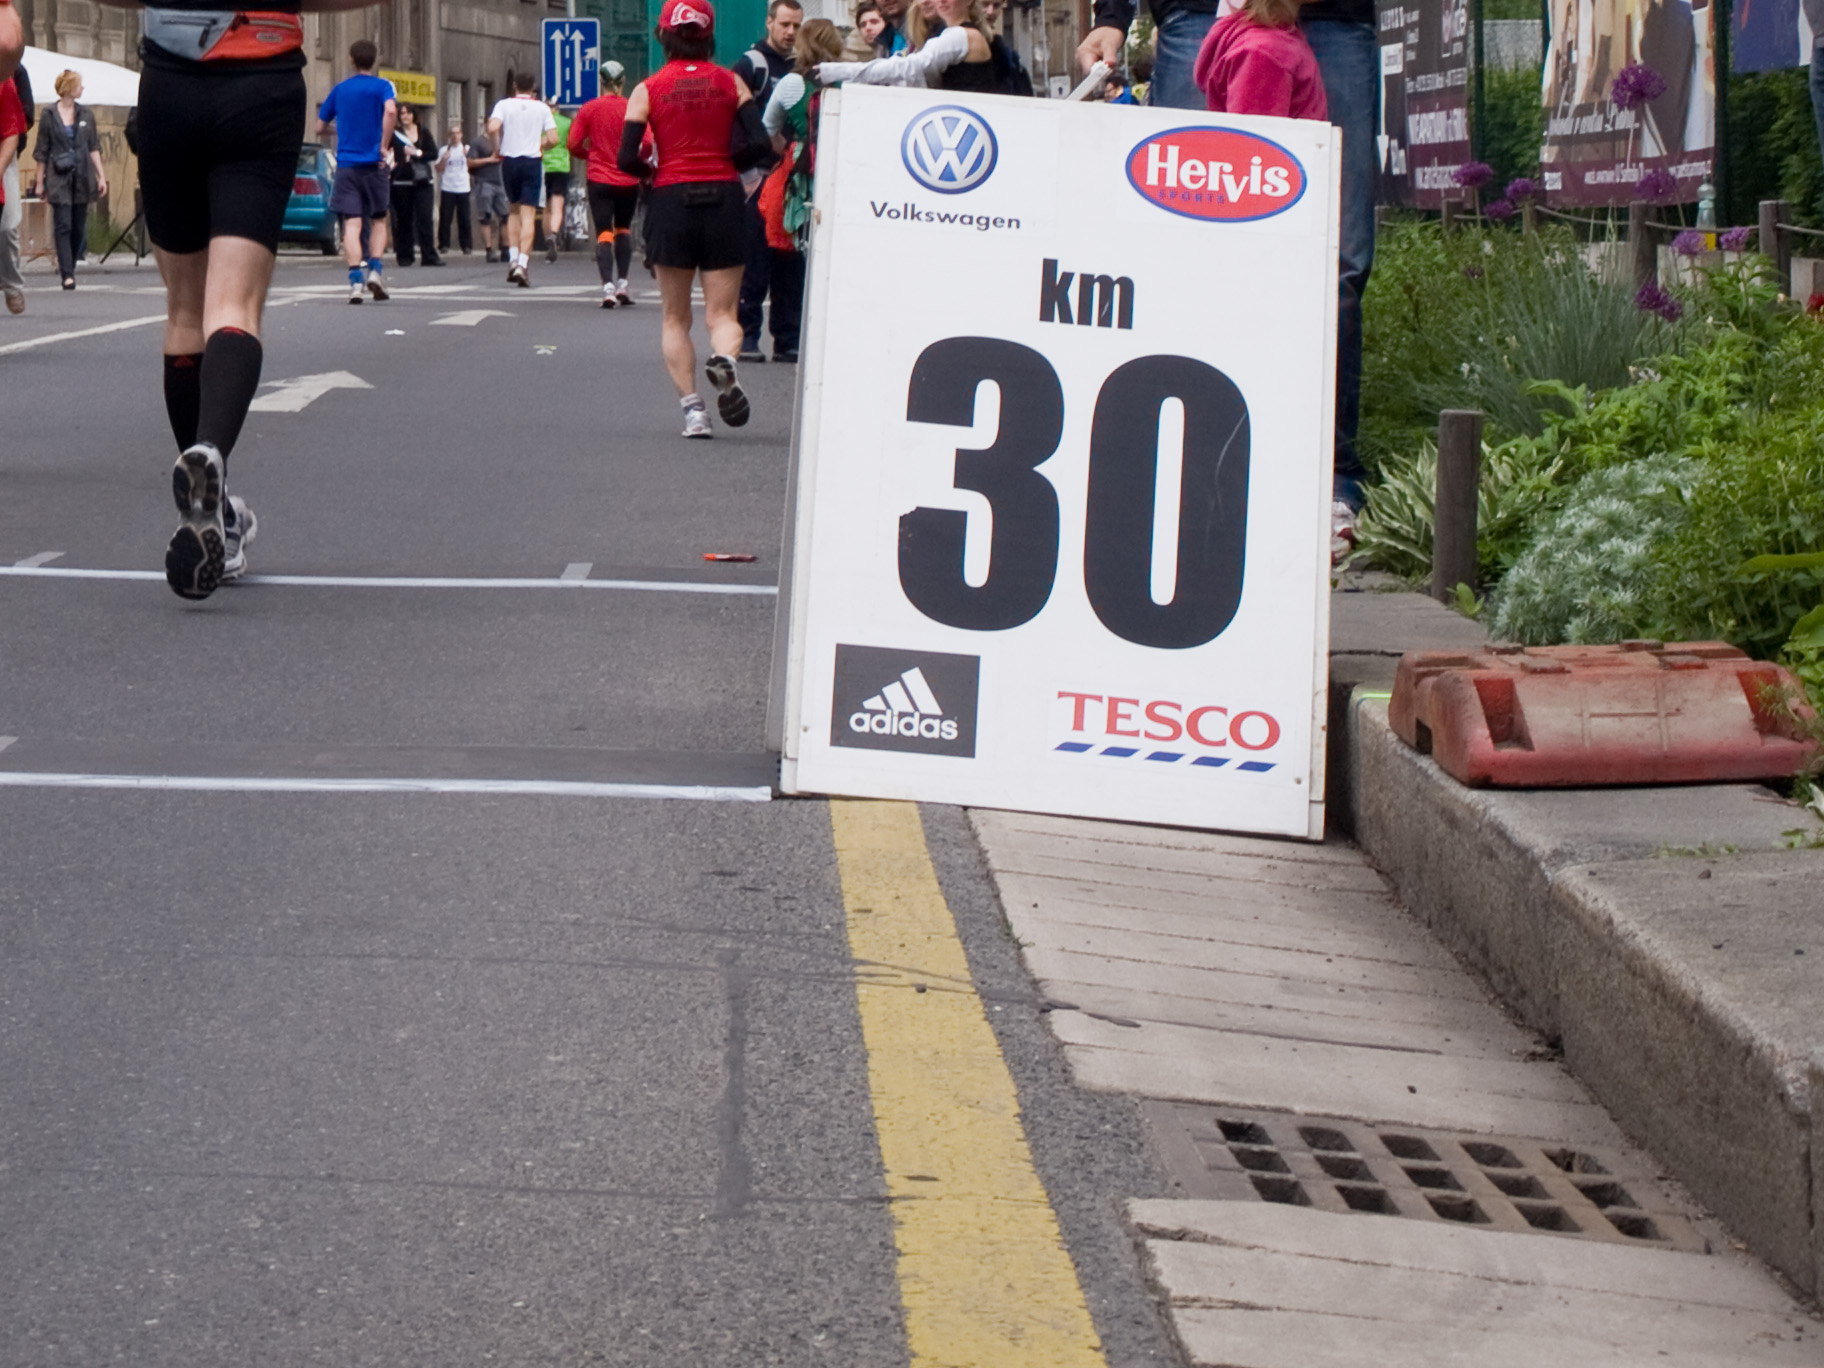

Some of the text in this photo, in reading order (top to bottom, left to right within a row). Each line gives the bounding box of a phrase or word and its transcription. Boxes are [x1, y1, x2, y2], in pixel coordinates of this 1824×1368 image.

[1145, 143, 1291, 203] Hervis
[1158, 189, 1225, 204] SPORTS
[869, 200, 1021, 232] Volkswagen
[1039, 257, 1135, 330] km
[897, 335, 1252, 649] 30
[849, 709, 959, 740] adidas
[1056, 690, 1282, 751] TESCO
